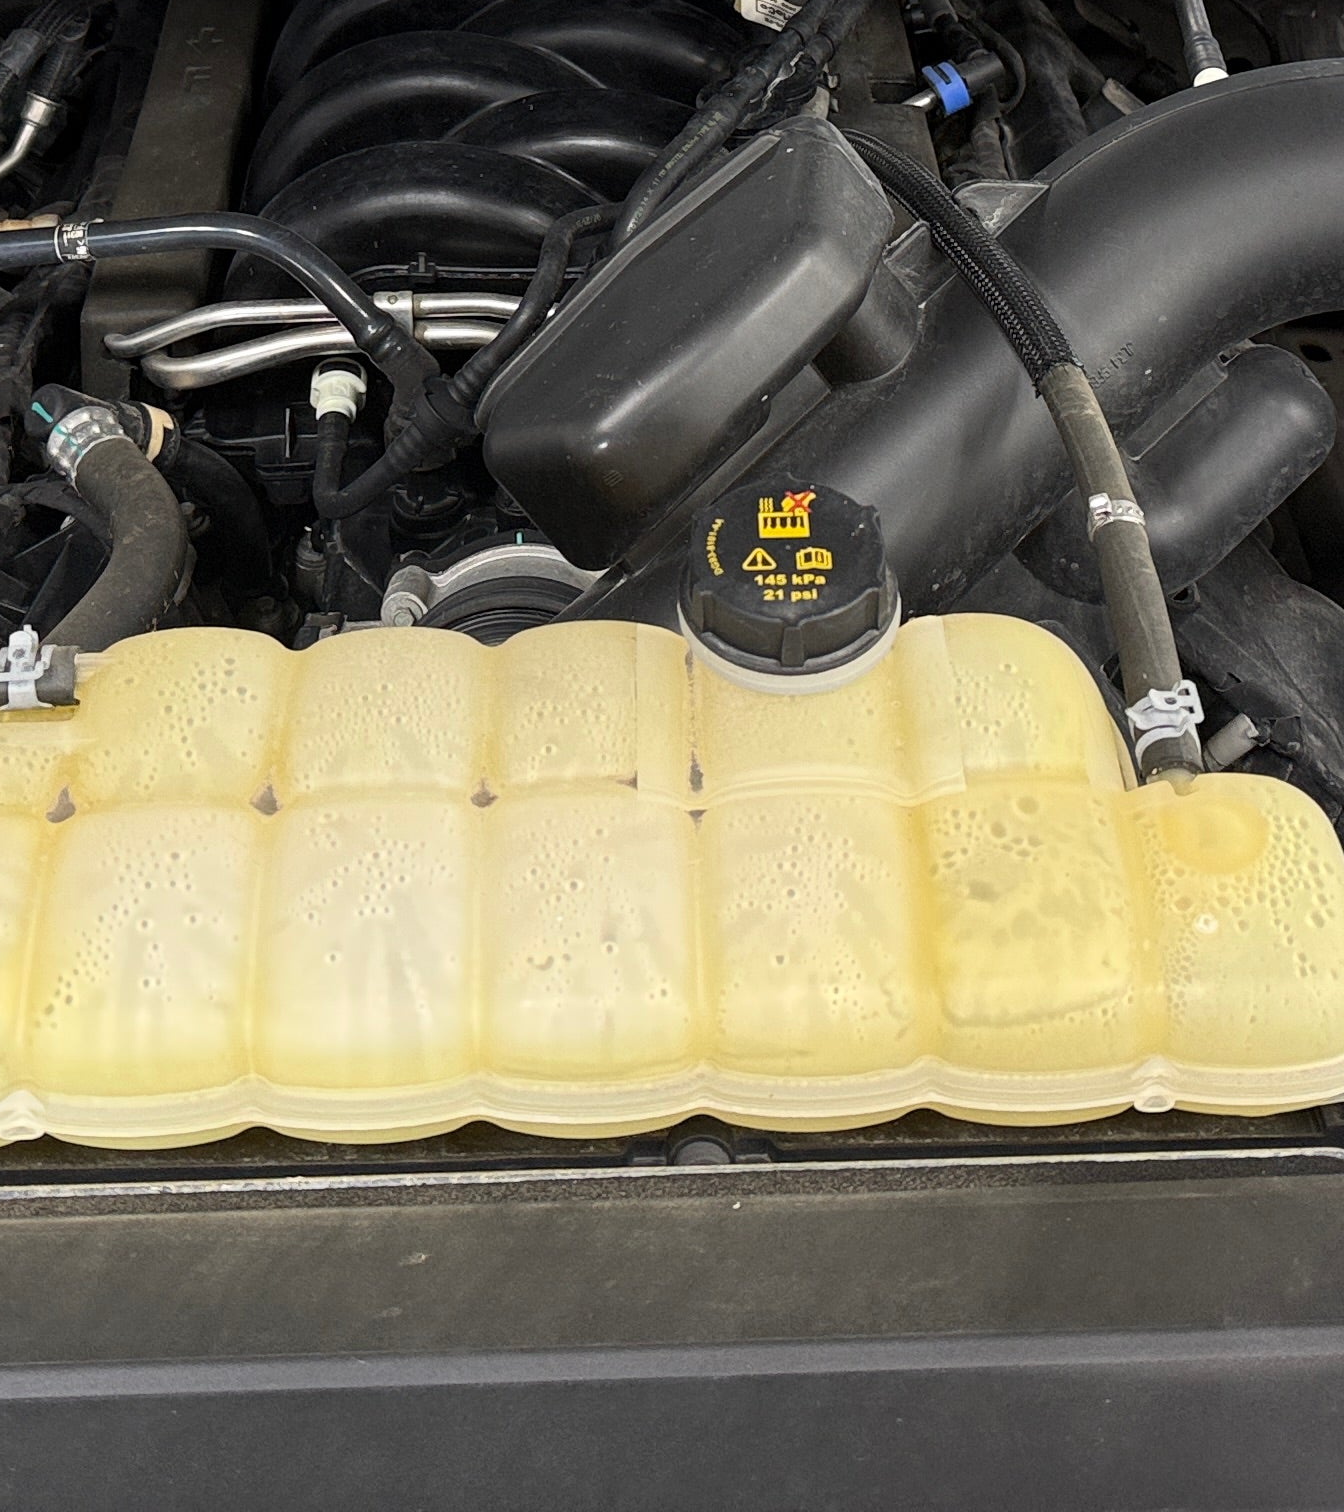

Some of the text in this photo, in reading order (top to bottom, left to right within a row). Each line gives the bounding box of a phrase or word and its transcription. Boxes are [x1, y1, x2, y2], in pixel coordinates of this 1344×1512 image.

[754, 574, 826, 586] 145 kPa
[763, 589, 818, 602] 21 psi
